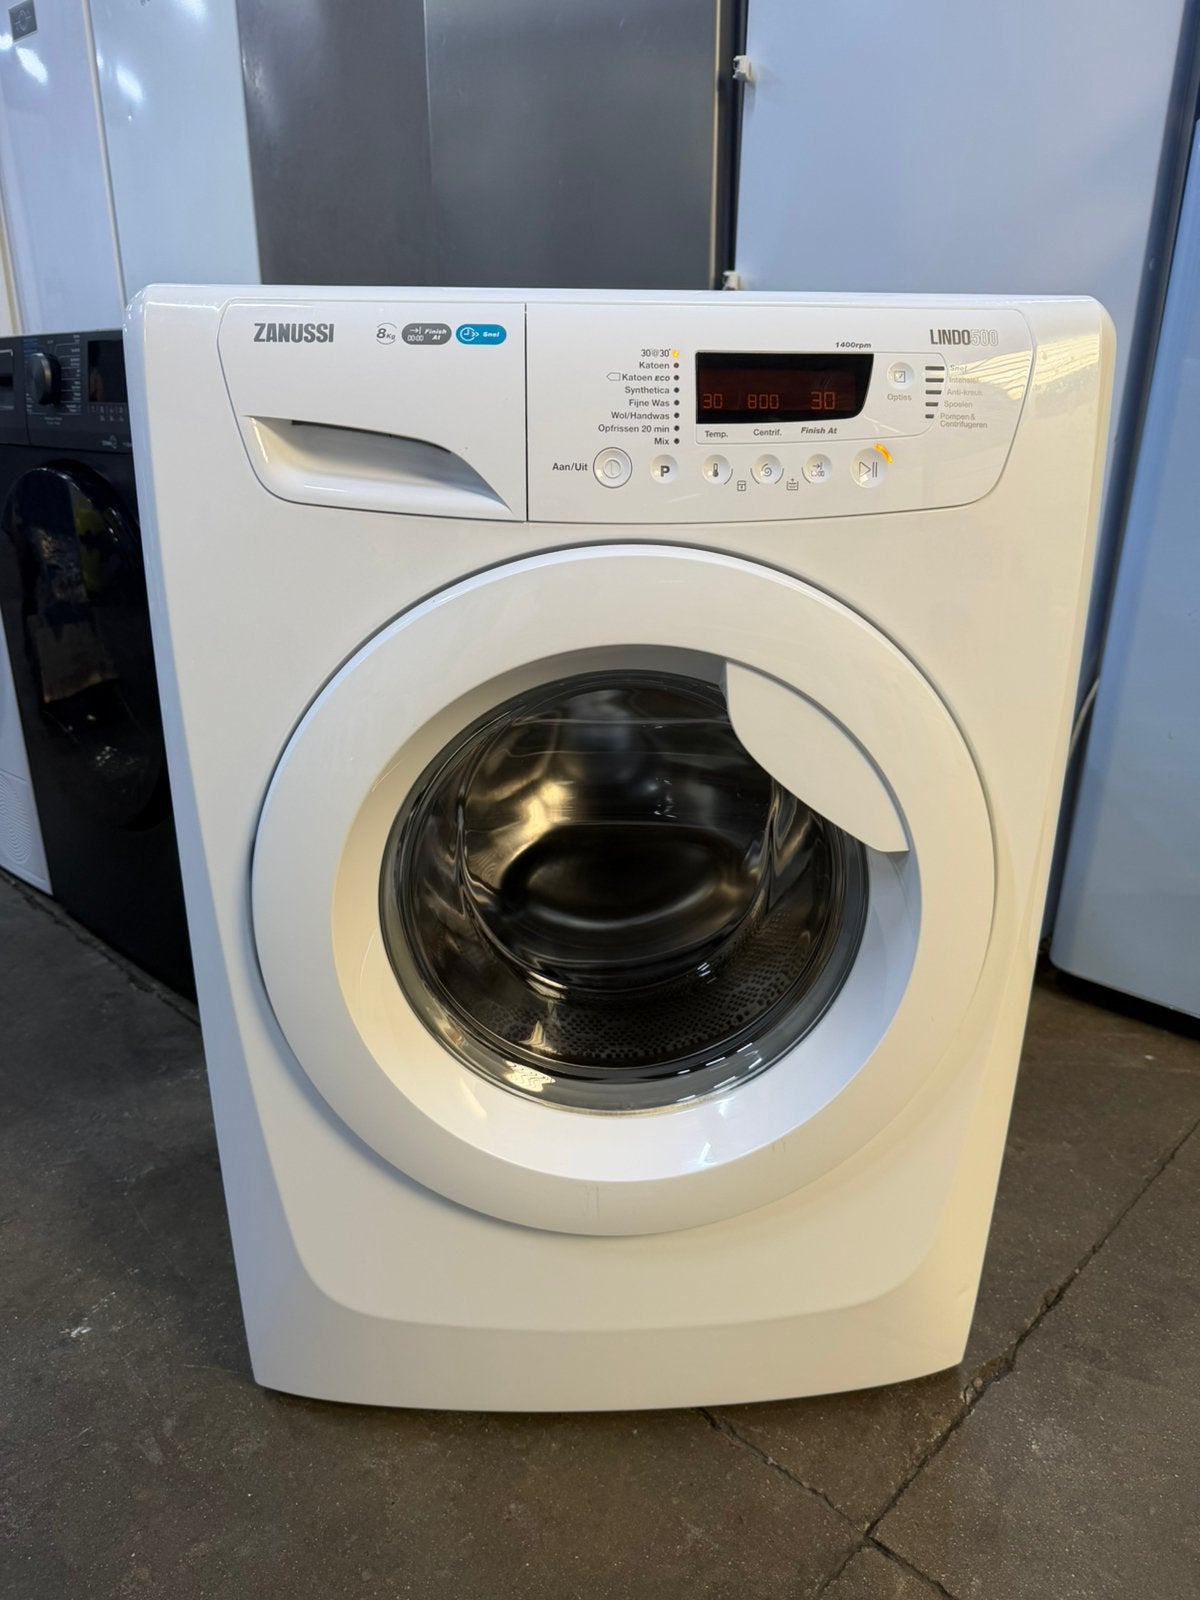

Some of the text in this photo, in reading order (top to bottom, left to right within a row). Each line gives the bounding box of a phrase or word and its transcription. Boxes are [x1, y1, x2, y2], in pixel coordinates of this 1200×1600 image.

[253, 322, 335, 343] ZANUSSI
[835, 341, 872, 349] 1400rpm
[639, 361, 670, 369] Katoen
[622, 373, 653, 382] Katoen
[624, 386, 670, 395] Synthetica
[629, 399, 670, 408] Fijne Was
[703, 391, 836, 410] 30 800 30
[611, 411, 670, 420] Wol/Handwas
[940, 413, 970, 421] Pompen
[598, 424, 670, 433] Opfrissen 20 min
[753, 428, 783, 437] Centrif.
[801, 426, 838, 434] Finish At
[704, 430, 728, 439] Temp.
[654, 437, 670, 445] Mix
[551, 463, 588, 472] Aan/Uit
[660, 465, 671, 477] P
